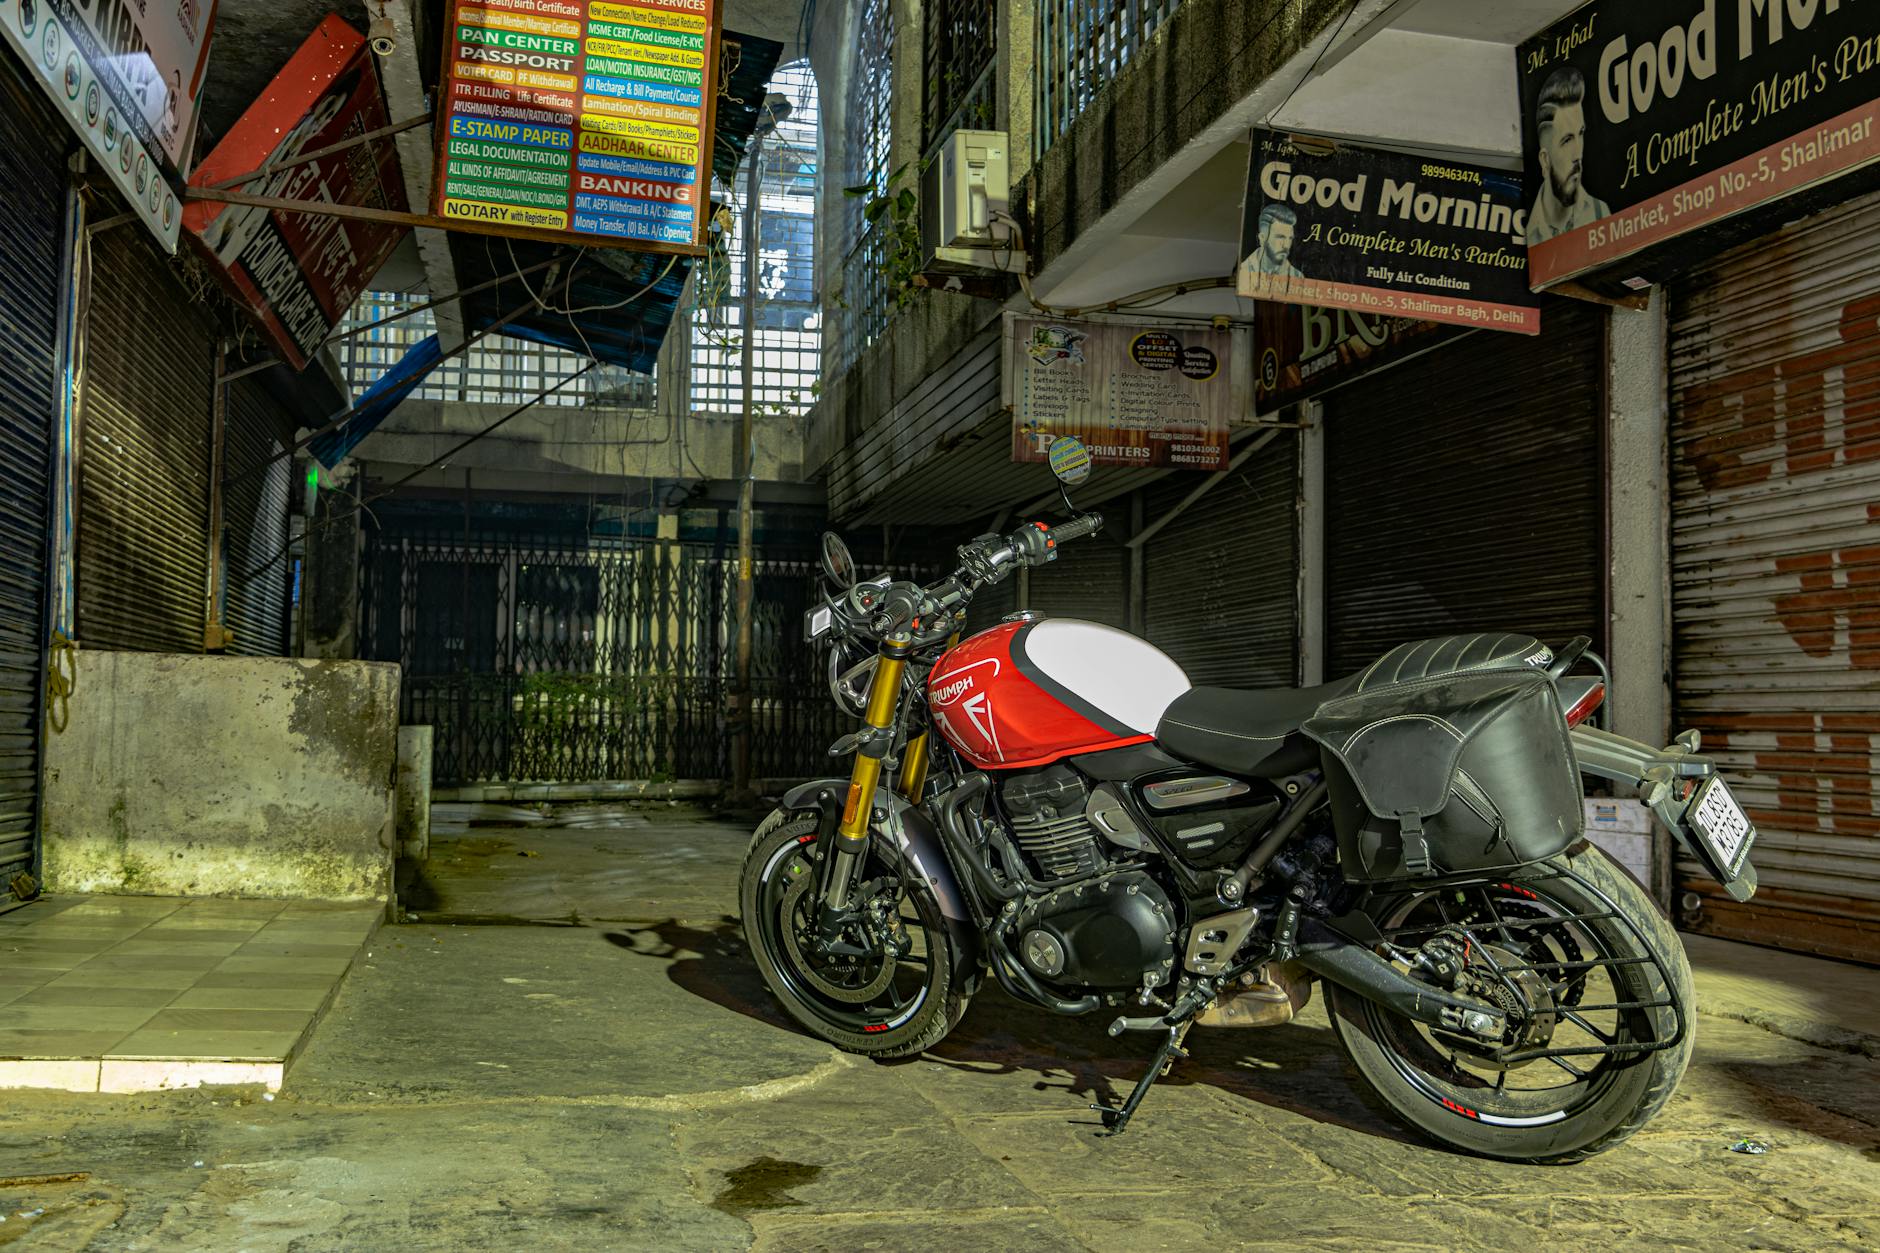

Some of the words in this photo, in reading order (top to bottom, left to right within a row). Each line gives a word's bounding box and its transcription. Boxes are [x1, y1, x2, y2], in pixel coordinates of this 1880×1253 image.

[536, 1, 580, 16] Certificate
[461, 28, 500, 44] PAN
[504, 34, 576, 54] CENTER
[588, 24, 612, 36] MSME
[654, 31, 704, 49] License/E-KYC
[1527, 47, 1548, 74] M.
[1554, 12, 1598, 61] Iqbal
[460, 46, 574, 71] PASSPORT
[586, 58, 633, 77] LOAN/MOTOR
[634, 63, 702, 85] INSURANCE/GST/NPS
[1598, 0, 1717, 125] Good
[457, 65, 487, 78] VOTER
[488, 68, 514, 82] CARD
[518, 71, 528, 83] PF
[529, 72, 574, 90] Withdrawal
[455, 83, 472, 96] ITR
[474, 86, 512, 101] FILLING
[517, 91, 532, 103] Life
[533, 93, 574, 109] Certificate
[585, 78, 595, 91] All
[596, 79, 625, 96] Recharge
[626, 83, 633, 93] &
[634, 84, 645, 97] Bill
[645, 87, 700, 104] Payment/Courier
[453, 101, 553, 122] AYUSHMAN/E-SHRAM/RATION
[554, 112, 574, 126] CARD
[583, 95, 663, 117] Lamination/Spiral
[664, 108, 699, 124] Binding
[1620, 145, 1639, 190] A
[1646, 99, 1744, 175] Complete
[1751, 55, 1828, 126] Men's
[452, 119, 519, 141] E-STAMP
[522, 128, 570, 148] PAPER
[450, 141, 480, 156] LEGAL
[482, 145, 569, 167] DOCUMENTATION
[583, 135, 646, 156] AADHAAR
[648, 143, 695, 162] CENTER
[449, 162, 461, 175] ALL
[461, 163, 482, 177] KINDS
[483, 165, 493, 177] OF
[493, 166, 567, 188] AFFIDAVIT/AGREEMENT
[578, 155, 600, 170] Update
[601, 157, 662, 177] Mobile/Email/Address
[663, 166, 669, 176] &
[670, 166, 682, 177] PVC
[683, 168, 695, 181] Card
[580, 175, 691, 201] BANKING
[1588, 226, 1606, 251] BS
[1609, 204, 1670, 242] Market,
[1672, 188, 1715, 218] Shop
[1720, 156, 1776, 198] No.-5,
[1780, 114, 1873, 173] Shalimar
[447, 201, 509, 221] NOTARY
[511, 211, 523, 222] with
[525, 212, 548, 226] Register
[549, 214, 564, 228] Entry
[592, 198, 608, 211] AEPS
[609, 199, 643, 216] Withdrawal
[644, 205, 650, 215] &
[650, 205, 662, 219] A/C
[663, 206, 693, 222] Statement
[1260, 161, 1367, 212] Good
[1378, 178, 1528, 246] Morning
[575, 215, 598, 233] Money
[599, 218, 627, 234] Transfer,
[638, 223, 650, 236] Bal.
[651, 224, 662, 239] A/c
[662, 225, 691, 244] Opening
[1303, 223, 1321, 243] A
[1327, 225, 1404, 256] Complete
[1409, 237, 1459, 262] Men's
[1464, 244, 1528, 271] Parlour
[239, 222, 299, 305] HOMOEO
[1367, 266, 1395, 282] Fully
[1396, 270, 1413, 284] Air
[1415, 272, 1471, 291] Condition
[275, 278, 316, 333] CARE
[1327, 286, 1358, 306] Shop
[1361, 291, 1398, 312] No.-5,
[1400, 296, 1454, 316] Shalimar
[1457, 302, 1490, 322] Bagh,
[1493, 307, 1524, 324] Delhi
[293, 306, 330, 357] ZONE
[1033, 385, 1063, 394] Visiting
[1066, 386, 1089, 394] Cards
[1060, 378, 1084, 386] Heads
[1121, 373, 1161, 381] Brochures
[1121, 381, 1154, 389] Wedding
[1071, 395, 1090, 404] Tags
[1120, 398, 1147, 406] Digital
[1167, 391, 1191, 399] Cards
[1120, 407, 1159, 416] Designing
[1120, 415, 1157, 423] Computer
[1088, 444, 1150, 458] PRINTERS
[928, 675, 974, 706] TRIUMPH
